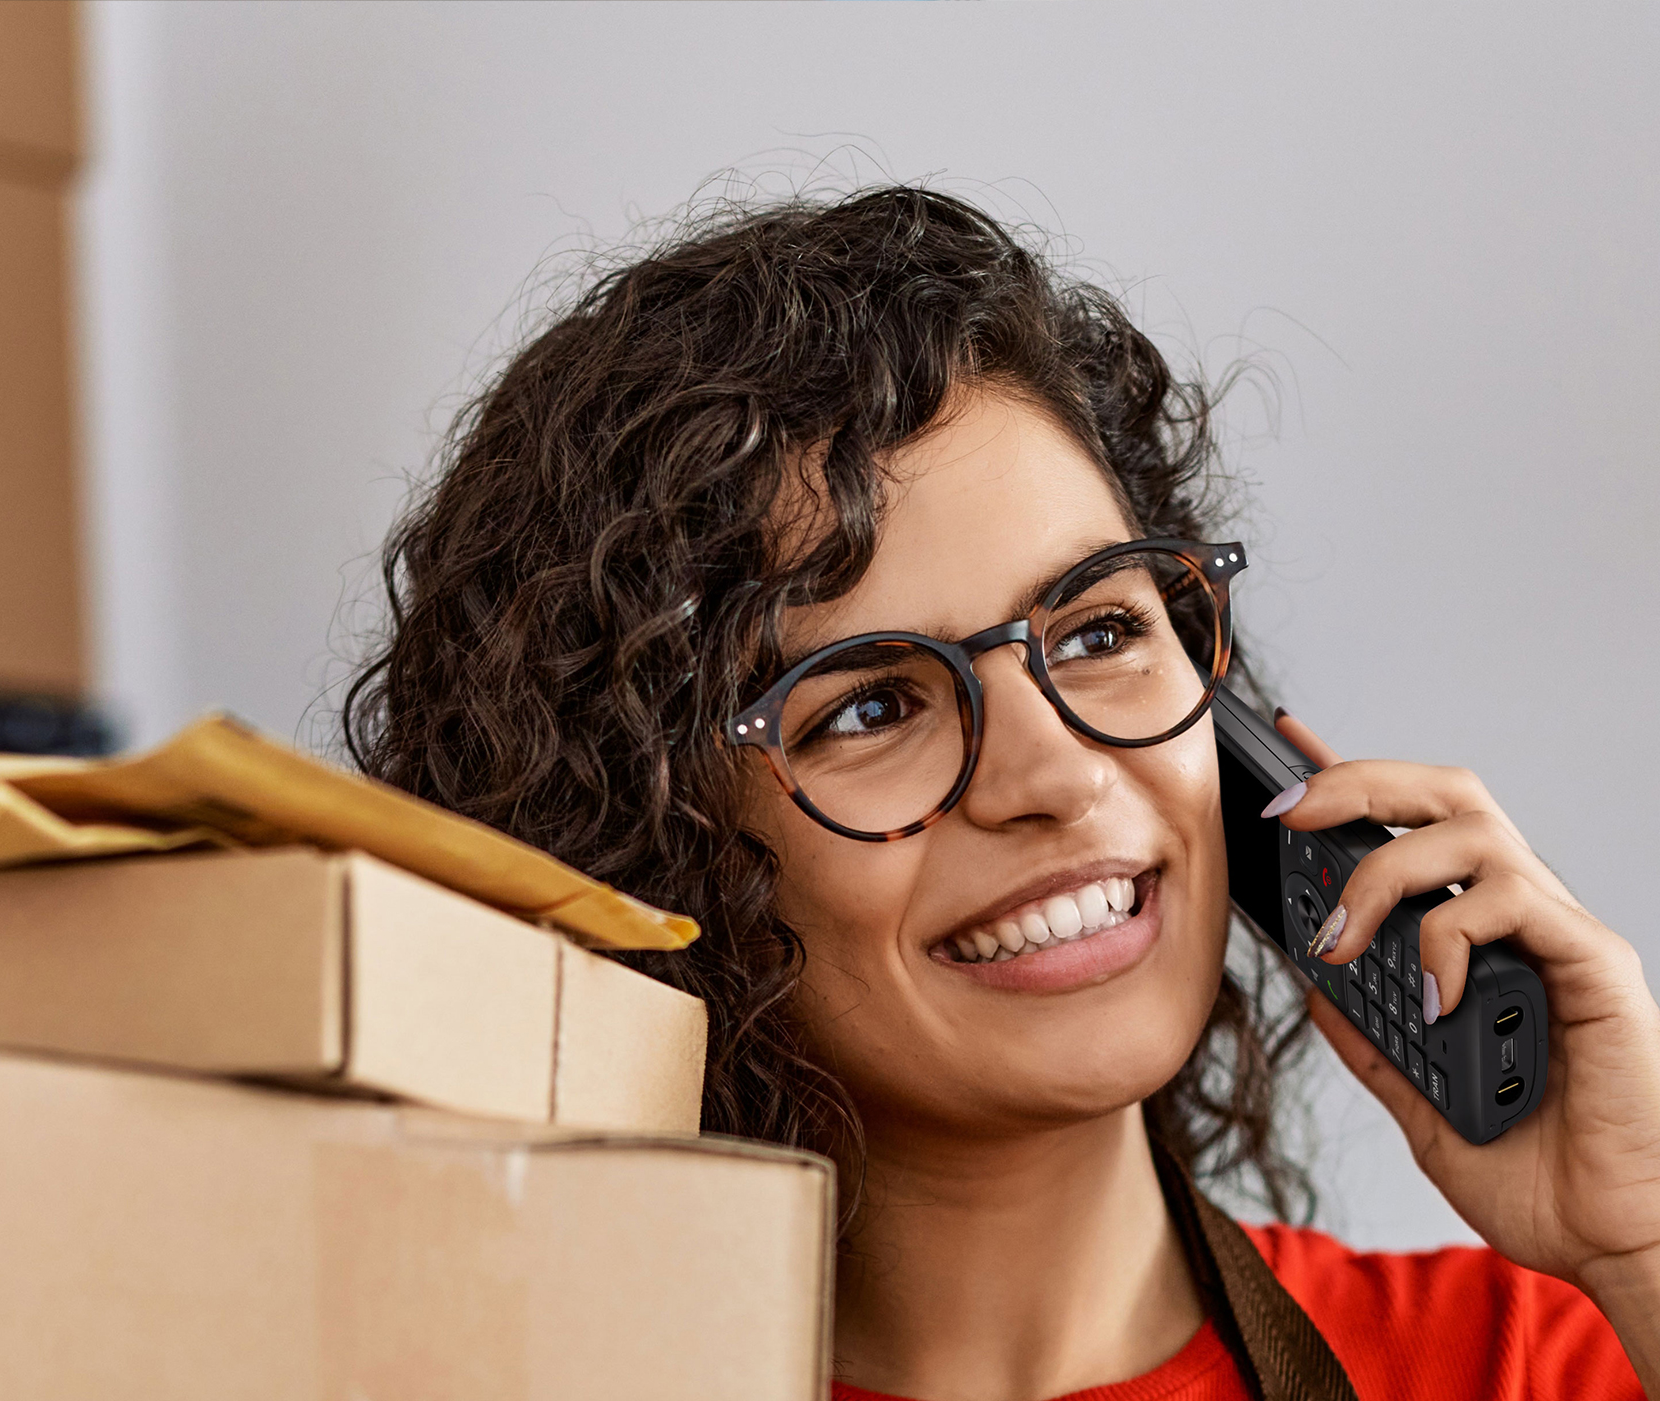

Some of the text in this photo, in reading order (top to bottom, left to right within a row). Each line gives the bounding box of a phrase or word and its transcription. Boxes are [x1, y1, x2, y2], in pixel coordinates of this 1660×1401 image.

[1387, 957, 1396, 970] 9
[1369, 982, 1378, 995] 5
[1353, 1008, 1361, 1018] 1
[1389, 1003, 1397, 1015] 8
[1372, 1027, 1381, 1039] 4
[1392, 1048, 1401, 1062] 7
[1432, 1073, 1440, 1101] TRAN
